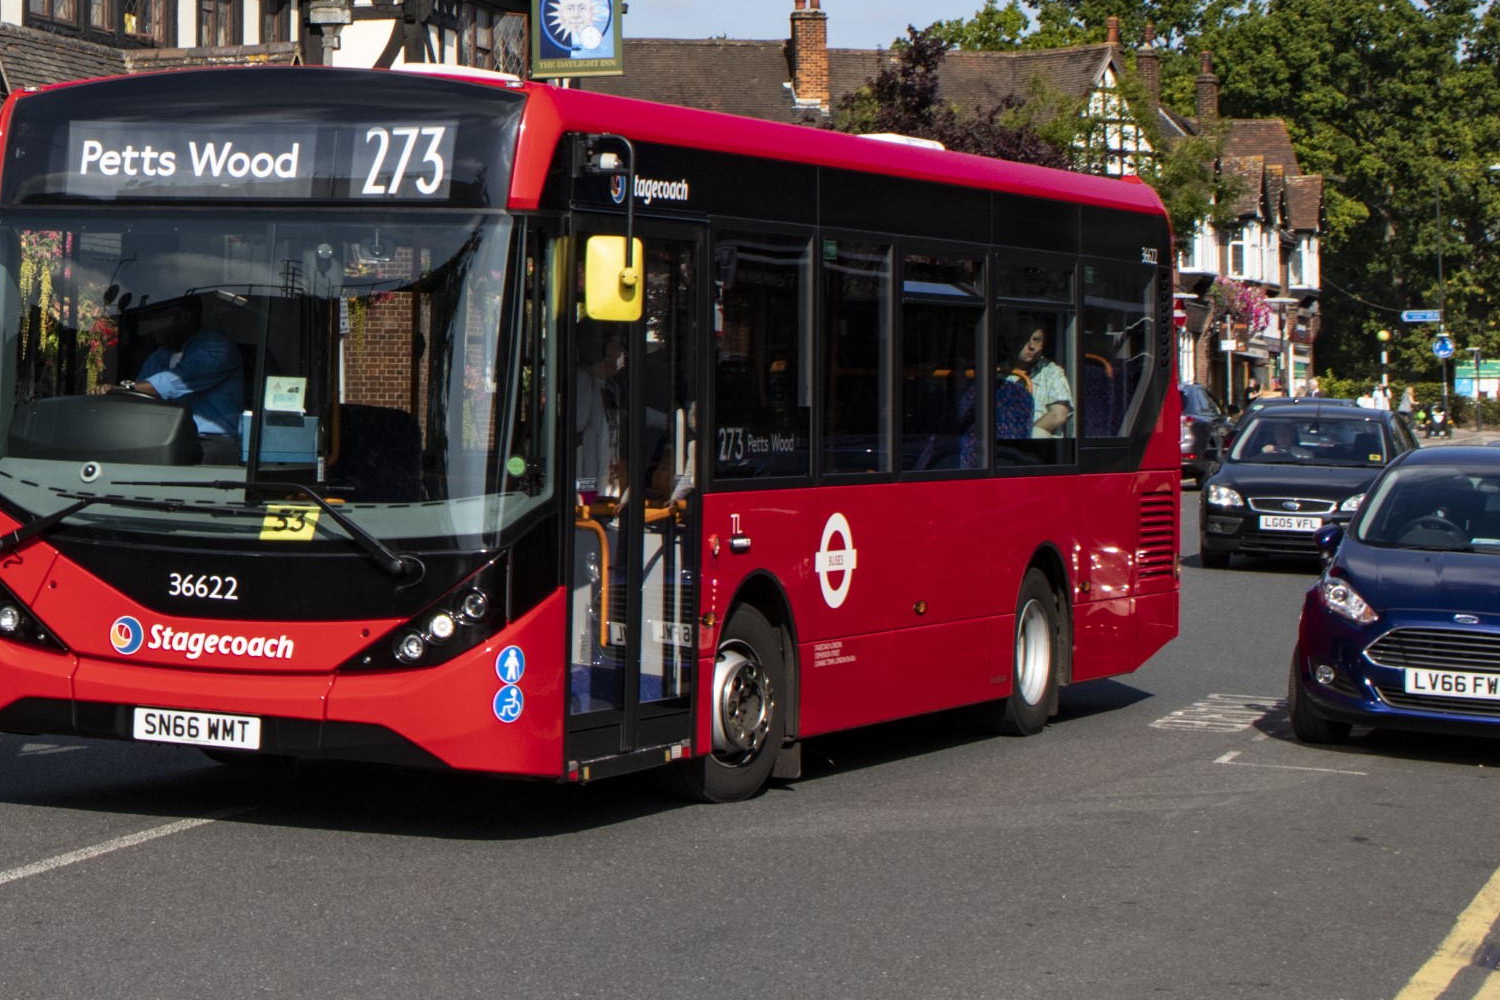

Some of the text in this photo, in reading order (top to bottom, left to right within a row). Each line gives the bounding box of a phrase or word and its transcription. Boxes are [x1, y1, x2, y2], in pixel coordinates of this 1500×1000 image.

[539, 58, 617, 69] THE DAYLIGHT INN
[80, 140, 300, 178] Petts Wood
[361, 126, 446, 195] 273
[633, 174, 689, 205] tagecoach
[719, 427, 744, 461] 273
[747, 432, 794, 452] Petts Wood
[730, 513, 743, 534] TL
[1264, 516, 1316, 529] LG05 VFL
[828, 554, 844, 566] BUSES
[168, 572, 239, 600] 36622
[147, 623, 294, 660] Stagecoach
[1414, 672, 1500, 695] LV66 FW
[144, 713, 250, 743] SN66 WMT
